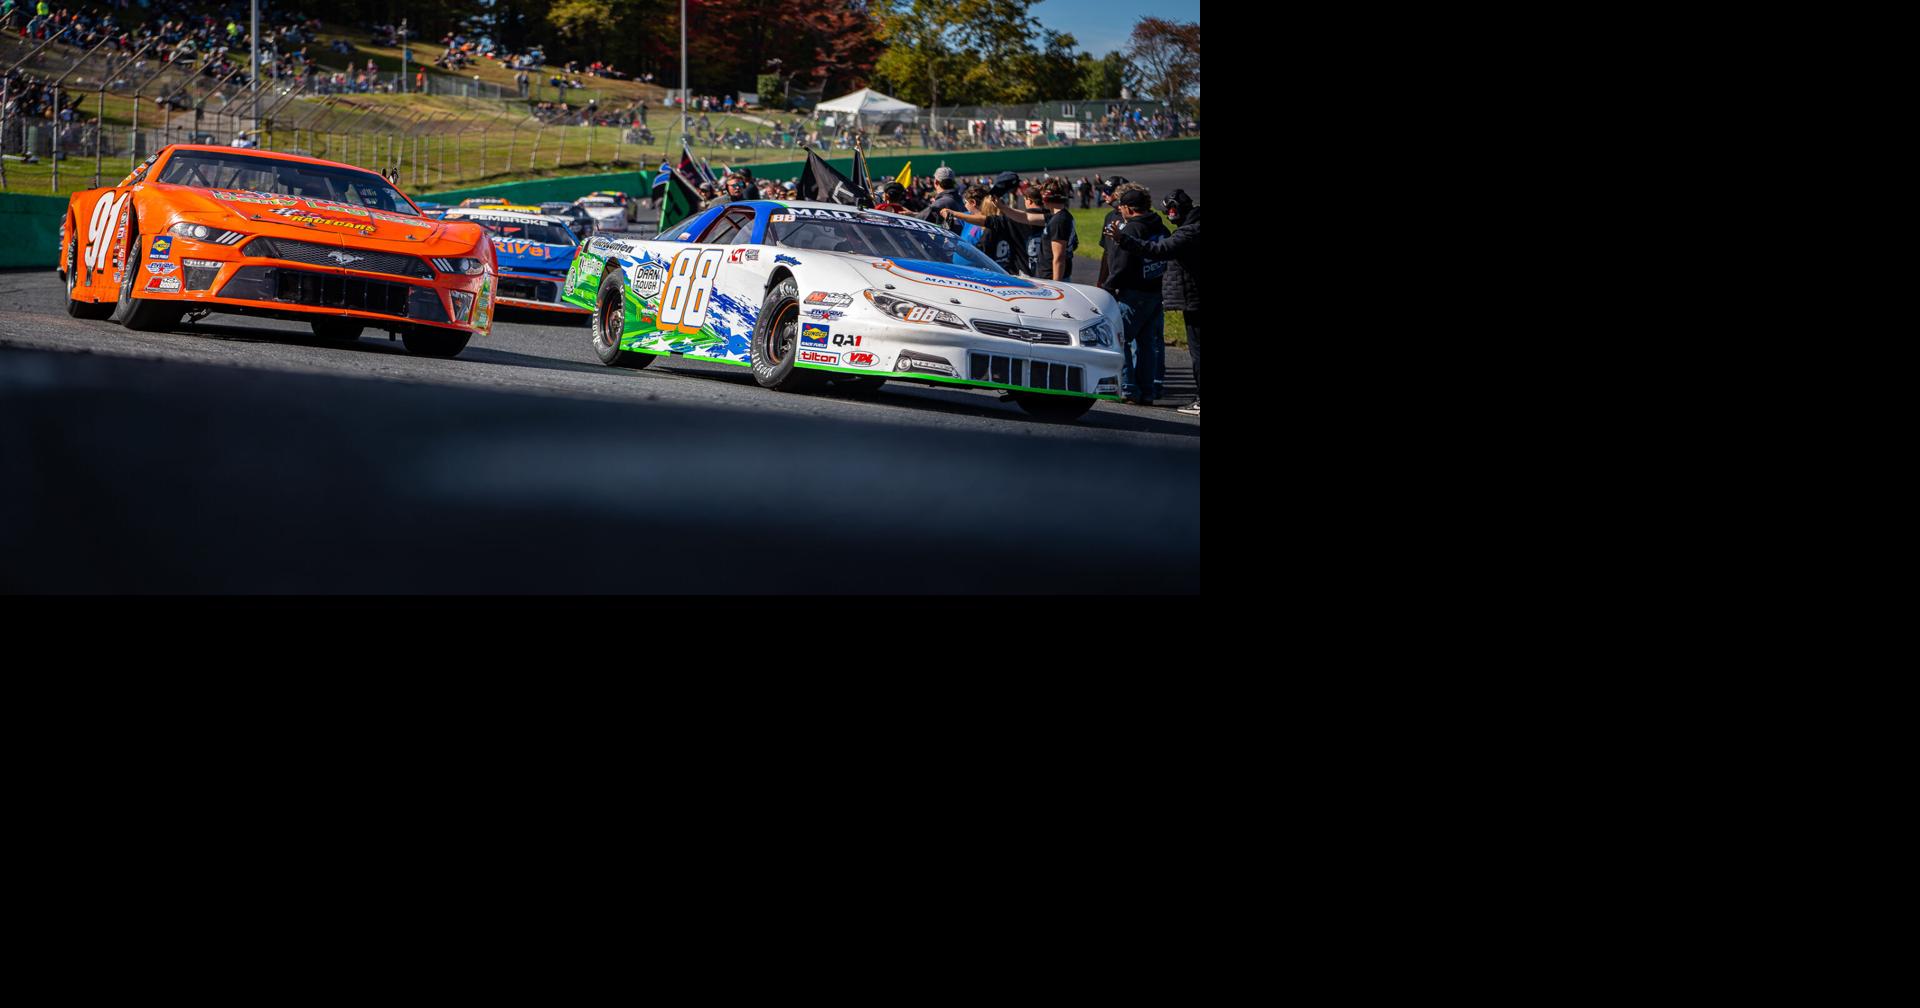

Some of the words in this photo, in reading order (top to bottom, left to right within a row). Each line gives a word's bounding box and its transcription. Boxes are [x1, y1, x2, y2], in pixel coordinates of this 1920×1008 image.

[469, 214, 549, 226] PEMBROKE
[771, 213, 796, 223] 88
[788, 209, 853, 219] MAD
[84, 190, 130, 274] 91
[637, 268, 660, 281] DARN
[636, 281, 657, 291] TOUGH
[656, 248, 724, 333] 88
[925, 277, 994, 294] MATTHEW
[905, 305, 939, 323] 88
[803, 330, 827, 338] SUNOCO
[832, 334, 862, 347] QA1
[801, 351, 837, 364] tilton
